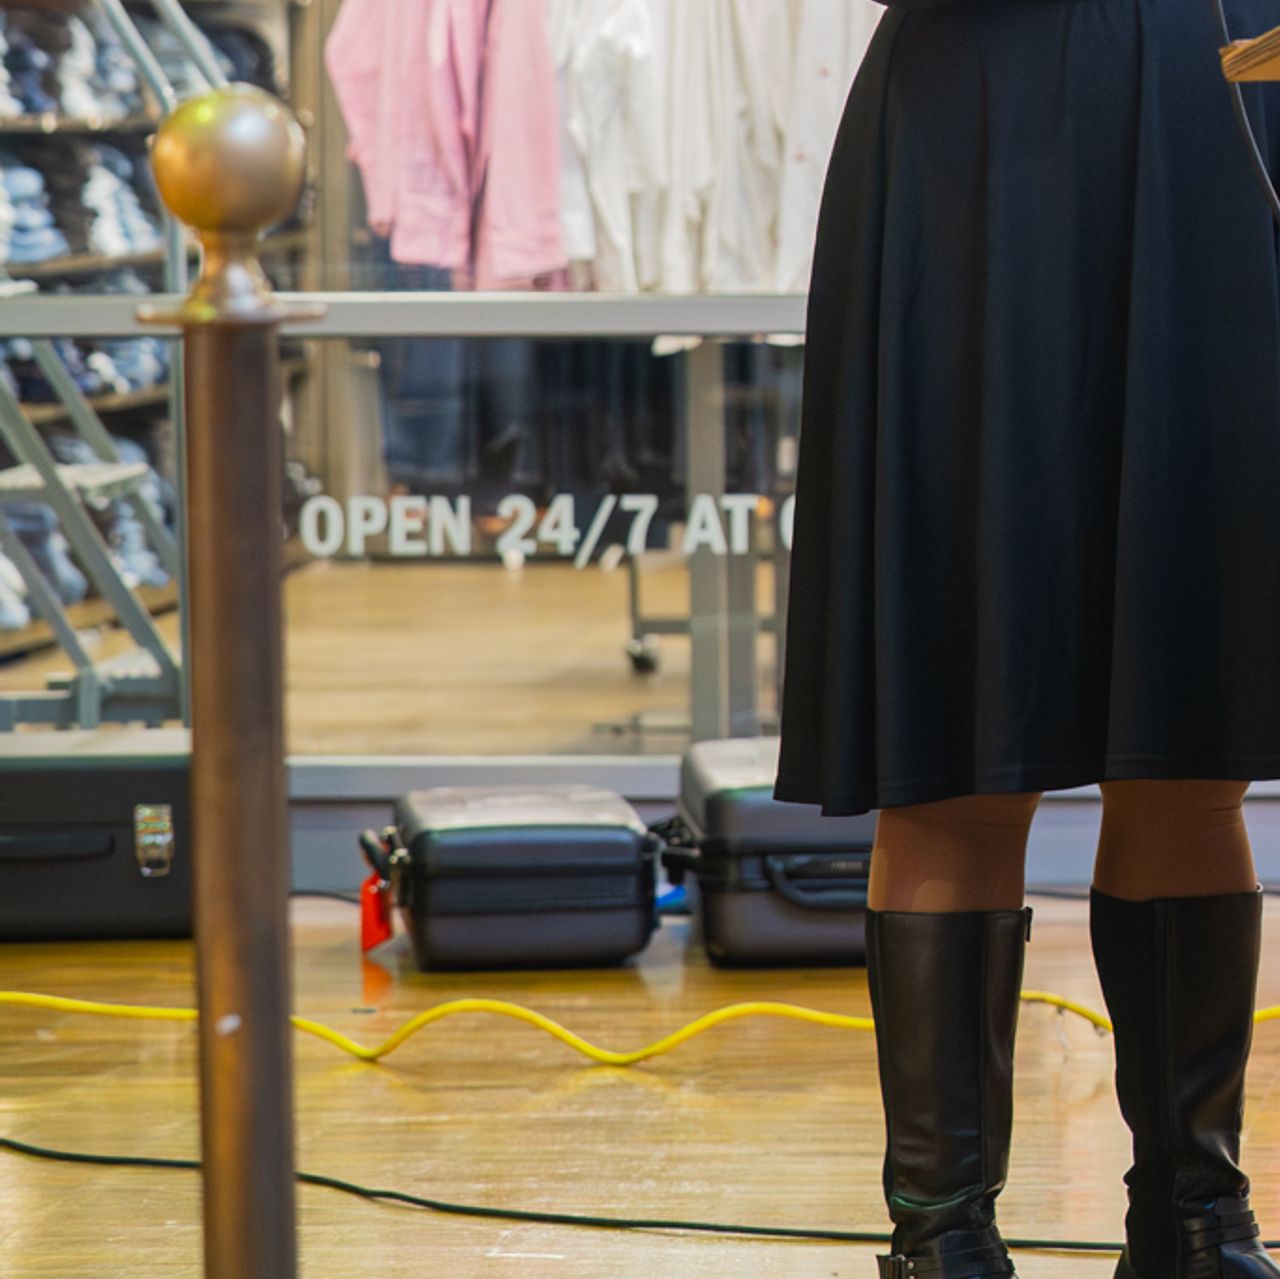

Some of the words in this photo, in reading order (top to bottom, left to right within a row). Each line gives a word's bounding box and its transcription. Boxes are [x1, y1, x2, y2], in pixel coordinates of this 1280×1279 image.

[302, 494, 472, 555] OPEN
[498, 494, 659, 569] 24/7
[682, 494, 759, 554] AT
